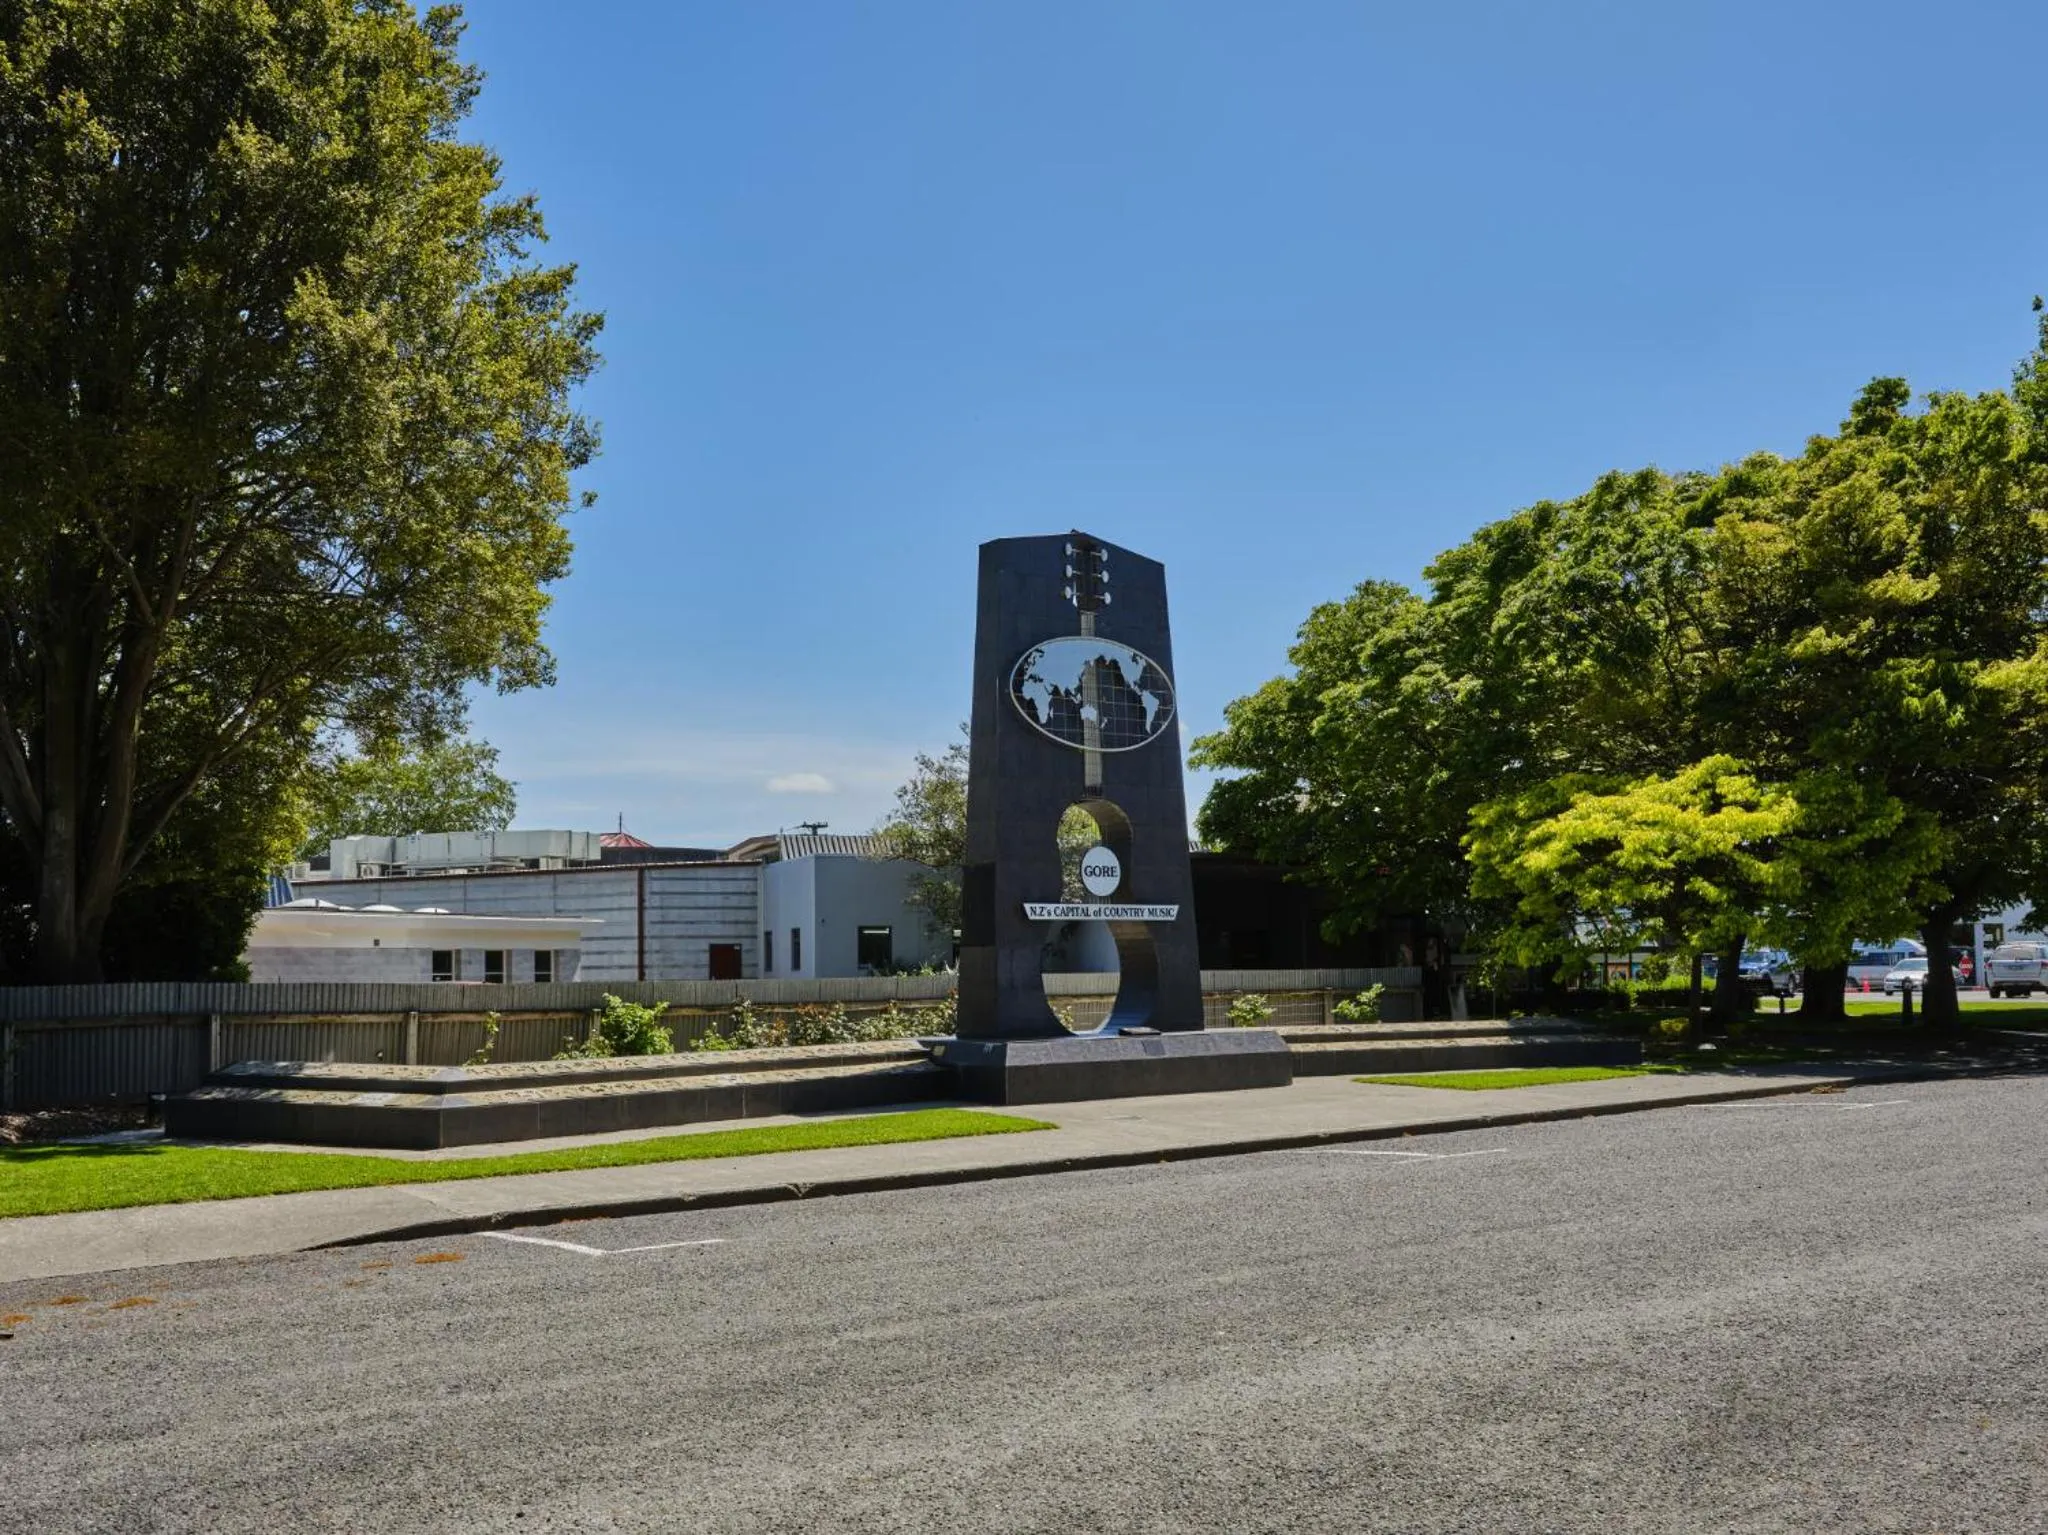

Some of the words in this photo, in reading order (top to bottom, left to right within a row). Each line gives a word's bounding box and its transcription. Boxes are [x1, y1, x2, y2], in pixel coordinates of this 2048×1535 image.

[1084, 865, 1118, 878] GORE
[1053, 906, 1091, 917] CAPITAL
[1093, 906, 1102, 917] of
[1104, 906, 1145, 917] COUNTRY
[1147, 907, 1175, 918] MUSIC
